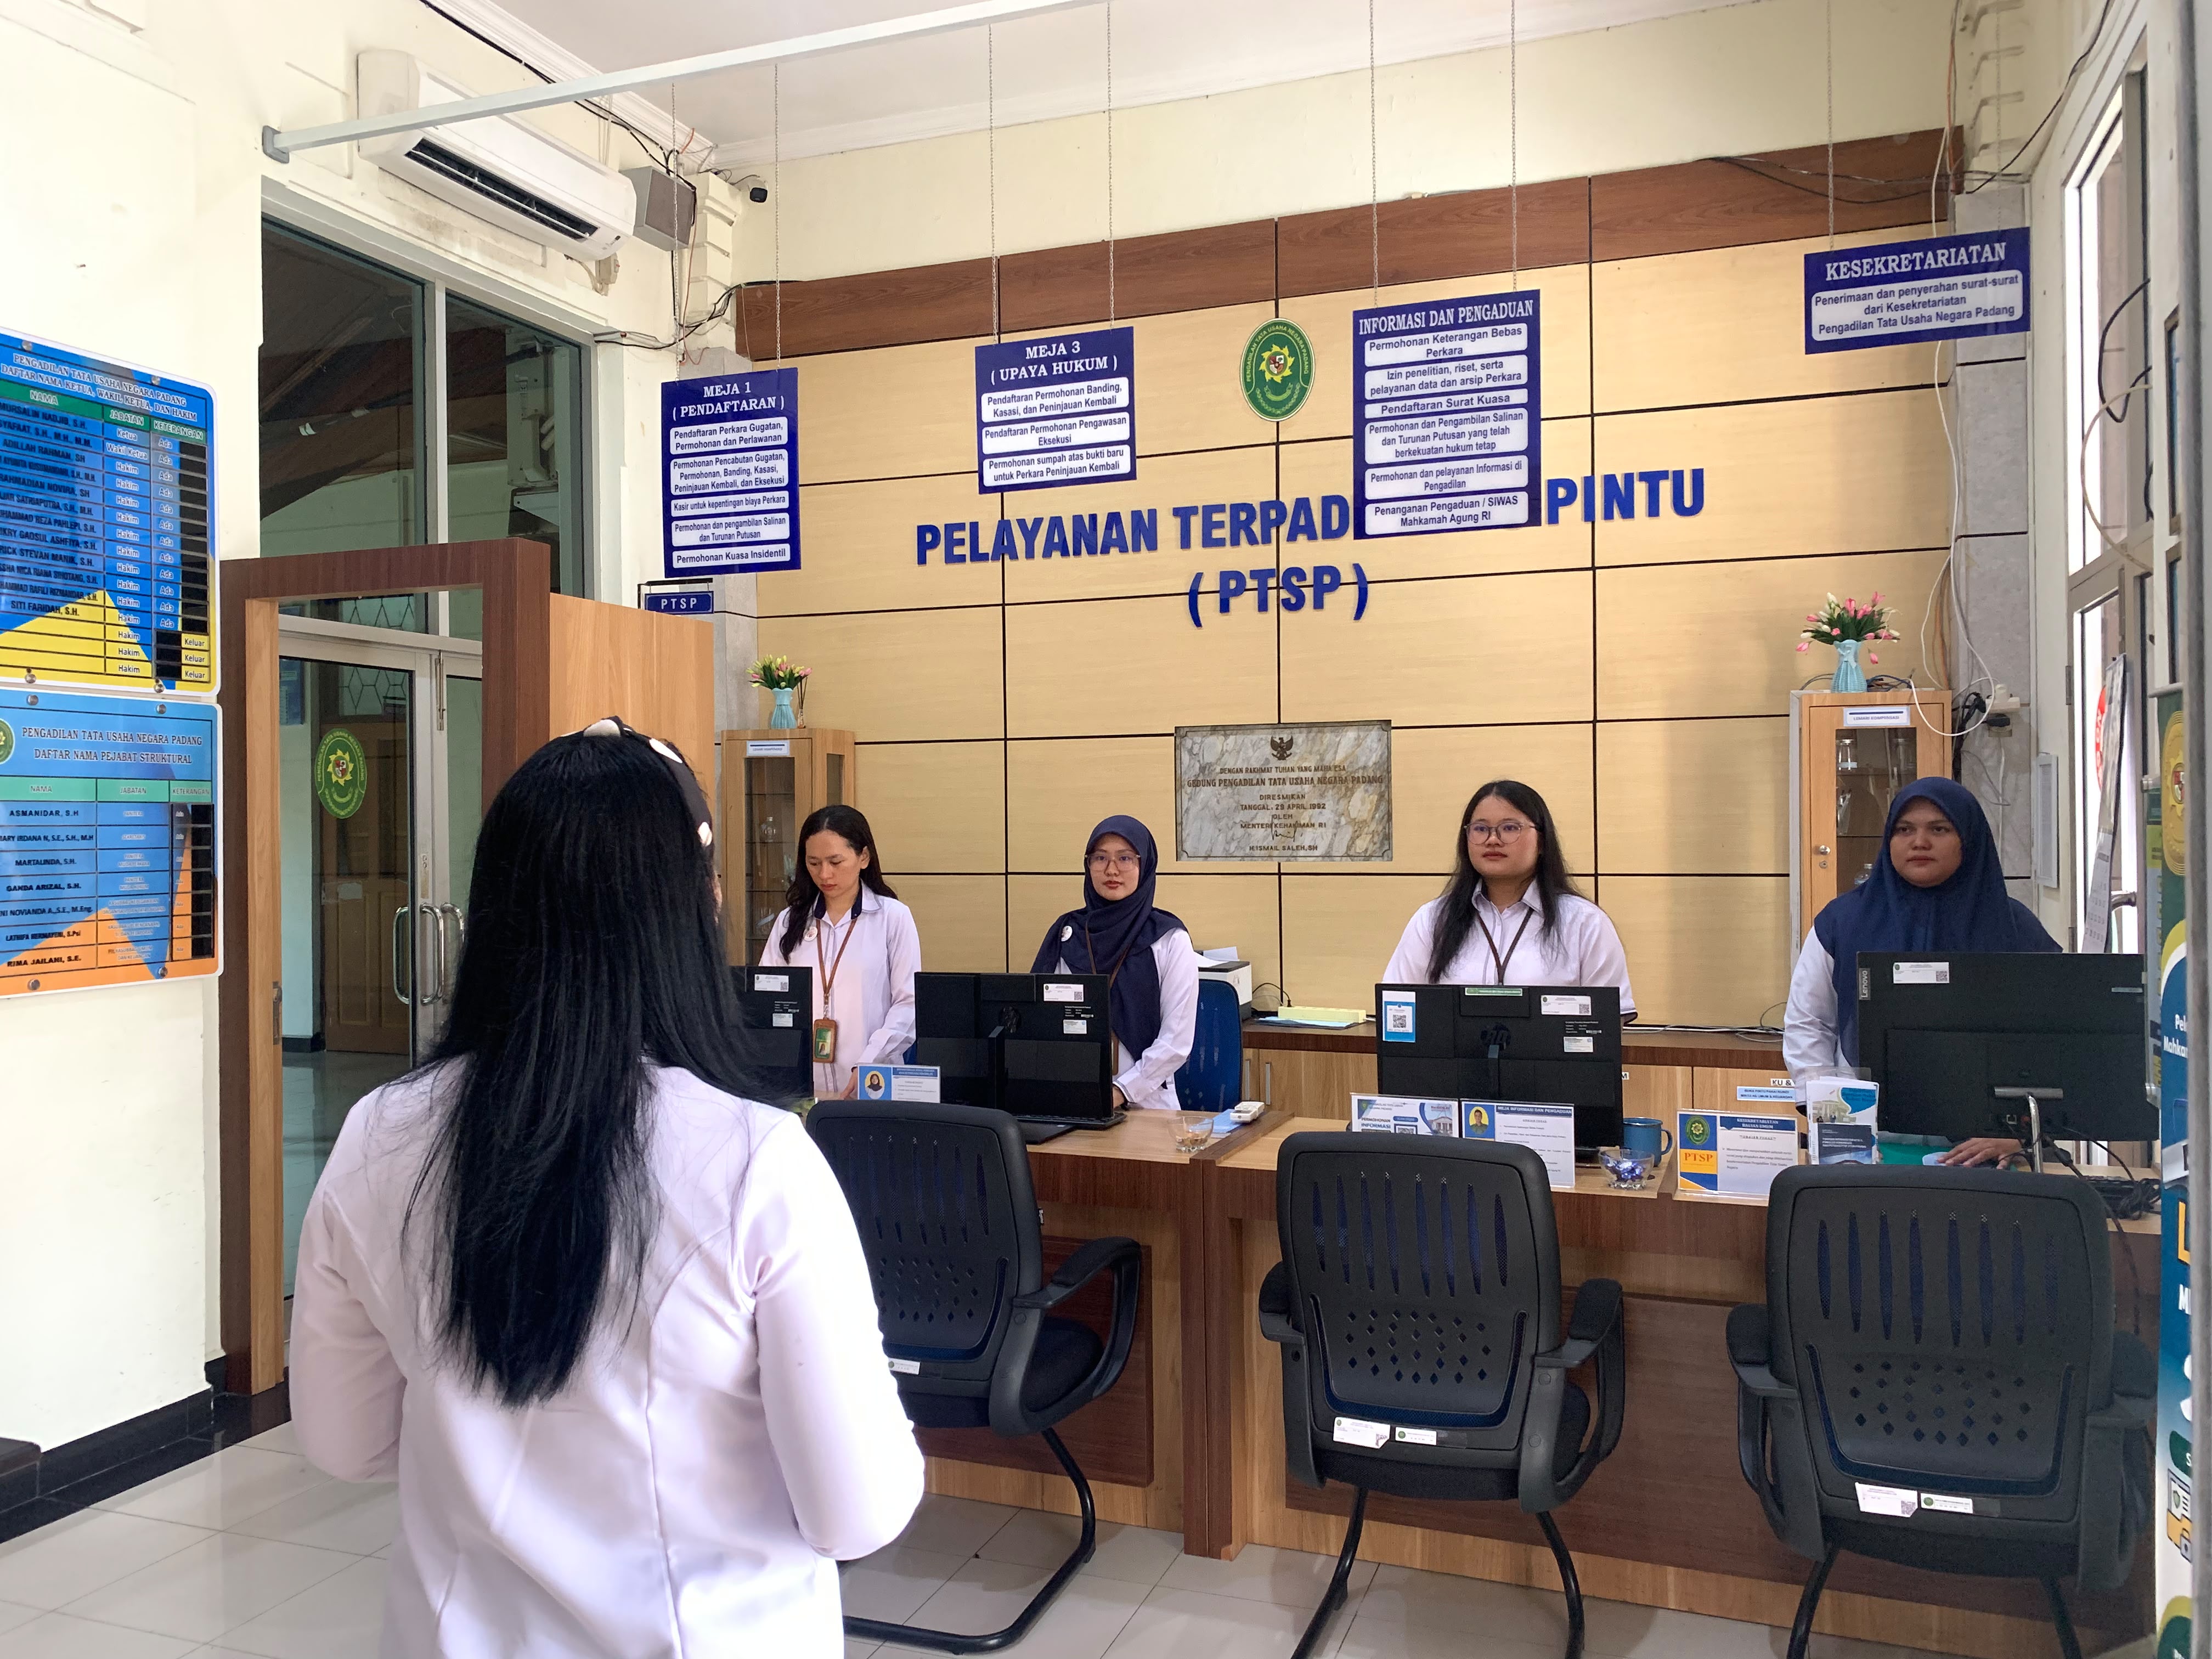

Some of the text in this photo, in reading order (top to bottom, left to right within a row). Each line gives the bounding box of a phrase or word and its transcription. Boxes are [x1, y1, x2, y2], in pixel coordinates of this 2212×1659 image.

[1826, 242, 2006, 281] KESEKRETARIATAN
[1815, 274, 2018, 306] Penerimaan dan penyerahan surat-surat
[1864, 296, 1966, 315] dari Kesekretariatan
[1359, 300, 1533, 335] INFORMASI DAN PENGADUAN
[1819, 306, 2015, 335] Pengadilan Tata Usaha Negara Padang
[1370, 327, 1522, 351] Permohonan Keterangan Bebas
[1026, 341, 1080, 359] MEJA 3
[1246, 343, 1257, 381] PENGADILAN
[1255, 331, 1267, 342] TATA
[1288, 328, 1304, 349] NEGARA
[1426, 347, 1463, 358] Perkara
[1000, 356, 1108, 381] UPAYA HUKUM
[1387, 360, 1503, 380] Izin penelitian, riset, serta
[13, 353, 186, 406] PENGADILAN TATA USAHA NEGARA PADANG
[703, 382, 751, 397] MEJA 1
[1370, 373, 1521, 397] pelayanan data dan arsip Perkara
[1, 364, 197, 421] DAFTAR NAMA KETUA, WAKIL KETUA, DAN HAKIM
[31, 391, 58, 405] NAMA
[988, 383, 1121, 405] Pendaftaran Permohonan Banding,
[680, 397, 776, 417] PENDAFTARAN
[994, 395, 1116, 417] Kasasi, dan Peninjauan Kembali
[1381, 395, 1510, 414] Pendaftaran Surat Kuasa
[110, 410, 203, 439] JABATAN KETERANGAN
[674, 422, 782, 439] Pendaftaran Perkara Gugatan,
[117, 428, 172, 449] Ketua Ada
[676, 435, 781, 450] Permohonan dan Perlawanan
[106, 443, 172, 465] Wakil Ketua Ada
[989, 449, 1124, 469] Permohonan sumpah atas bukti baru
[116, 462, 172, 481] Hakim Ada
[994, 461, 1119, 481] untuk Perkara Peninjauan Kembali
[1375, 495, 1518, 516] Penanganan Pengaduan SIWAS
[917, 468, 1705, 565] PELAYANAN TERPAD PINTU
[1401, 511, 1491, 526] Mahkamah Agung RI
[677, 548, 786, 563] Permohonan Kuasa Insidentil
[1218, 565, 1341, 614] PTSP
[662, 598, 697, 610] PTSP
[119, 648, 205, 663] Hakim Keluar
[119, 665, 205, 679] Hakim Keluar
[22, 727, 202, 746] PENGADILAN TATA USAHA NEGARA PADANG
[35, 749, 191, 764] DAFTAR NAMA PEJABAT STRUKTURAL
[1187, 778, 1216, 787] GEDUNG
[1218, 778, 1265, 788] PENGADILAN
[1289, 777, 1315, 786] USAHA
[1317, 776, 1348, 785] NEGARA
[1351, 776, 1383, 785] PADANG
[2163, 1035, 2188, 1058] Mahka
[1684, 1152, 1713, 1163] PTSP
